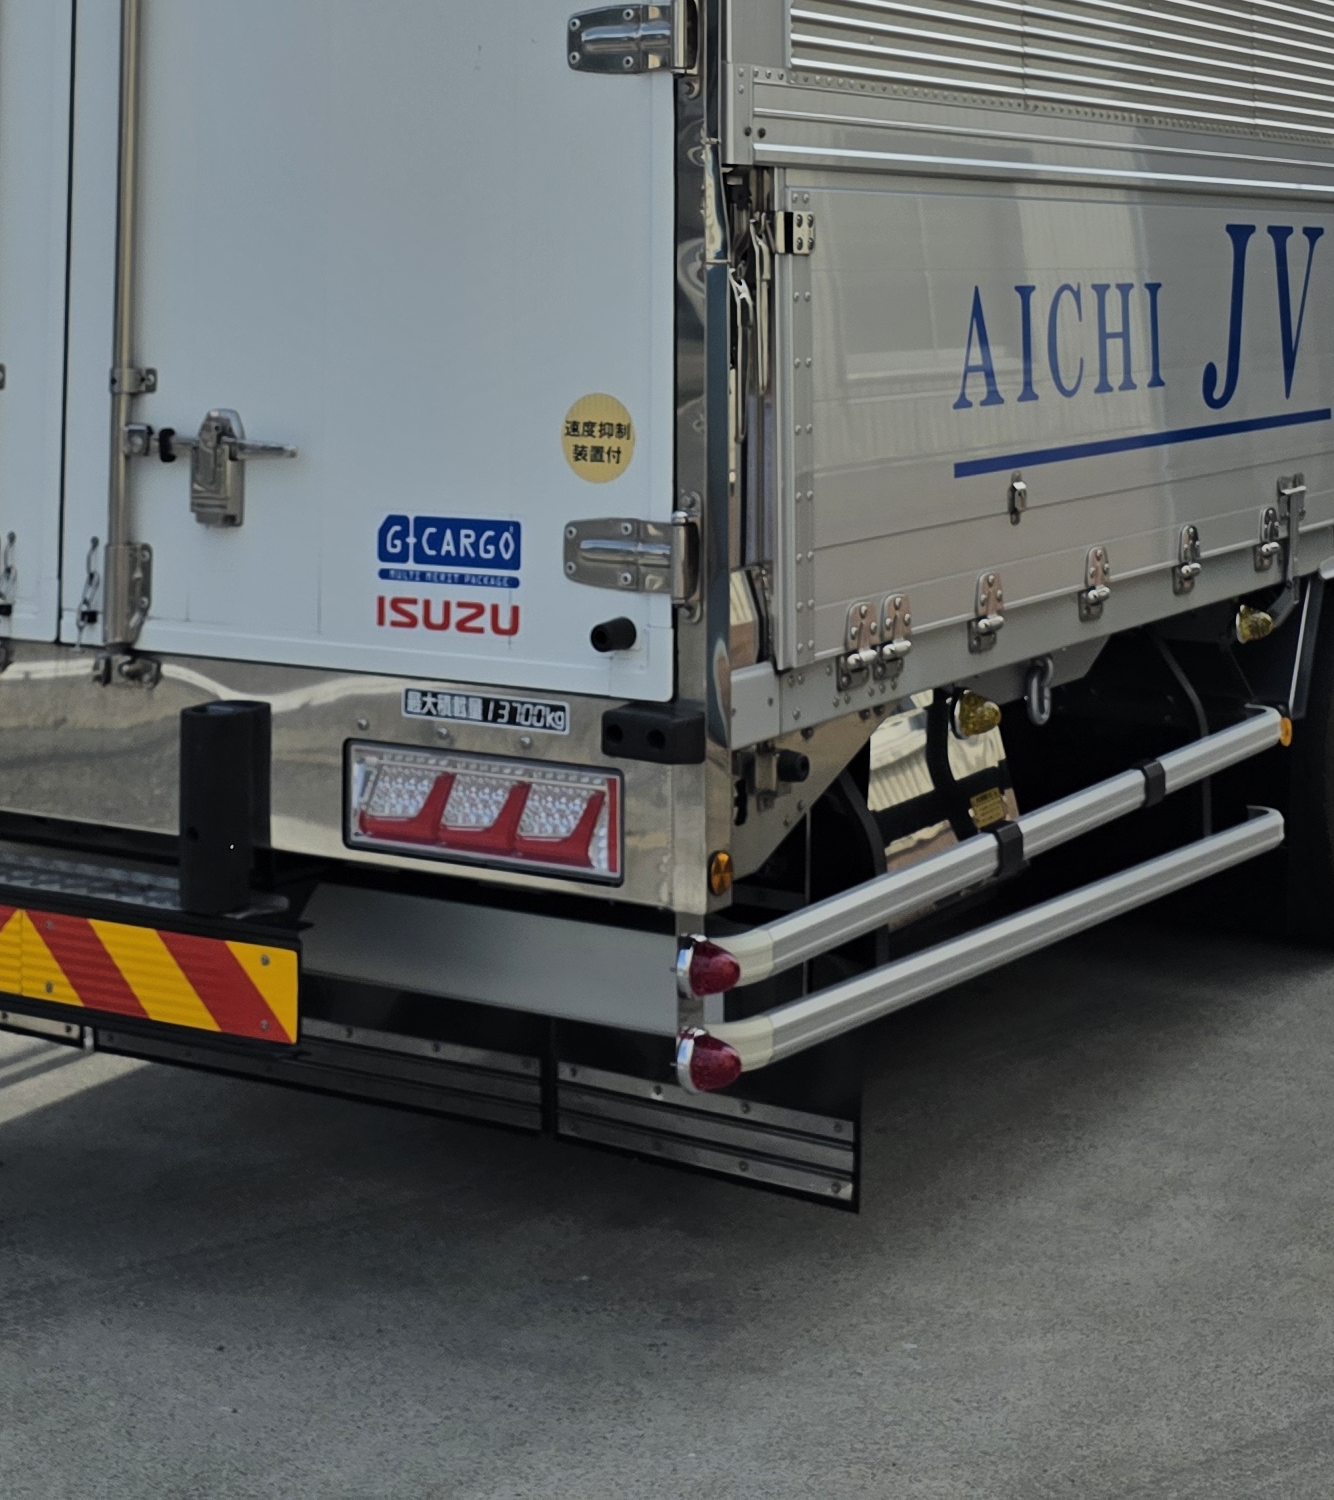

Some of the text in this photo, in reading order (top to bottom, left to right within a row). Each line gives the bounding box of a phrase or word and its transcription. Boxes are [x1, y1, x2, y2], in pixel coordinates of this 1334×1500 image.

[952, 222, 1325, 410] AICHI JV
[564, 420, 632, 441] 速度抑制
[572, 444, 622, 464] 装置付
[376, 595, 520, 637] ISUZU
